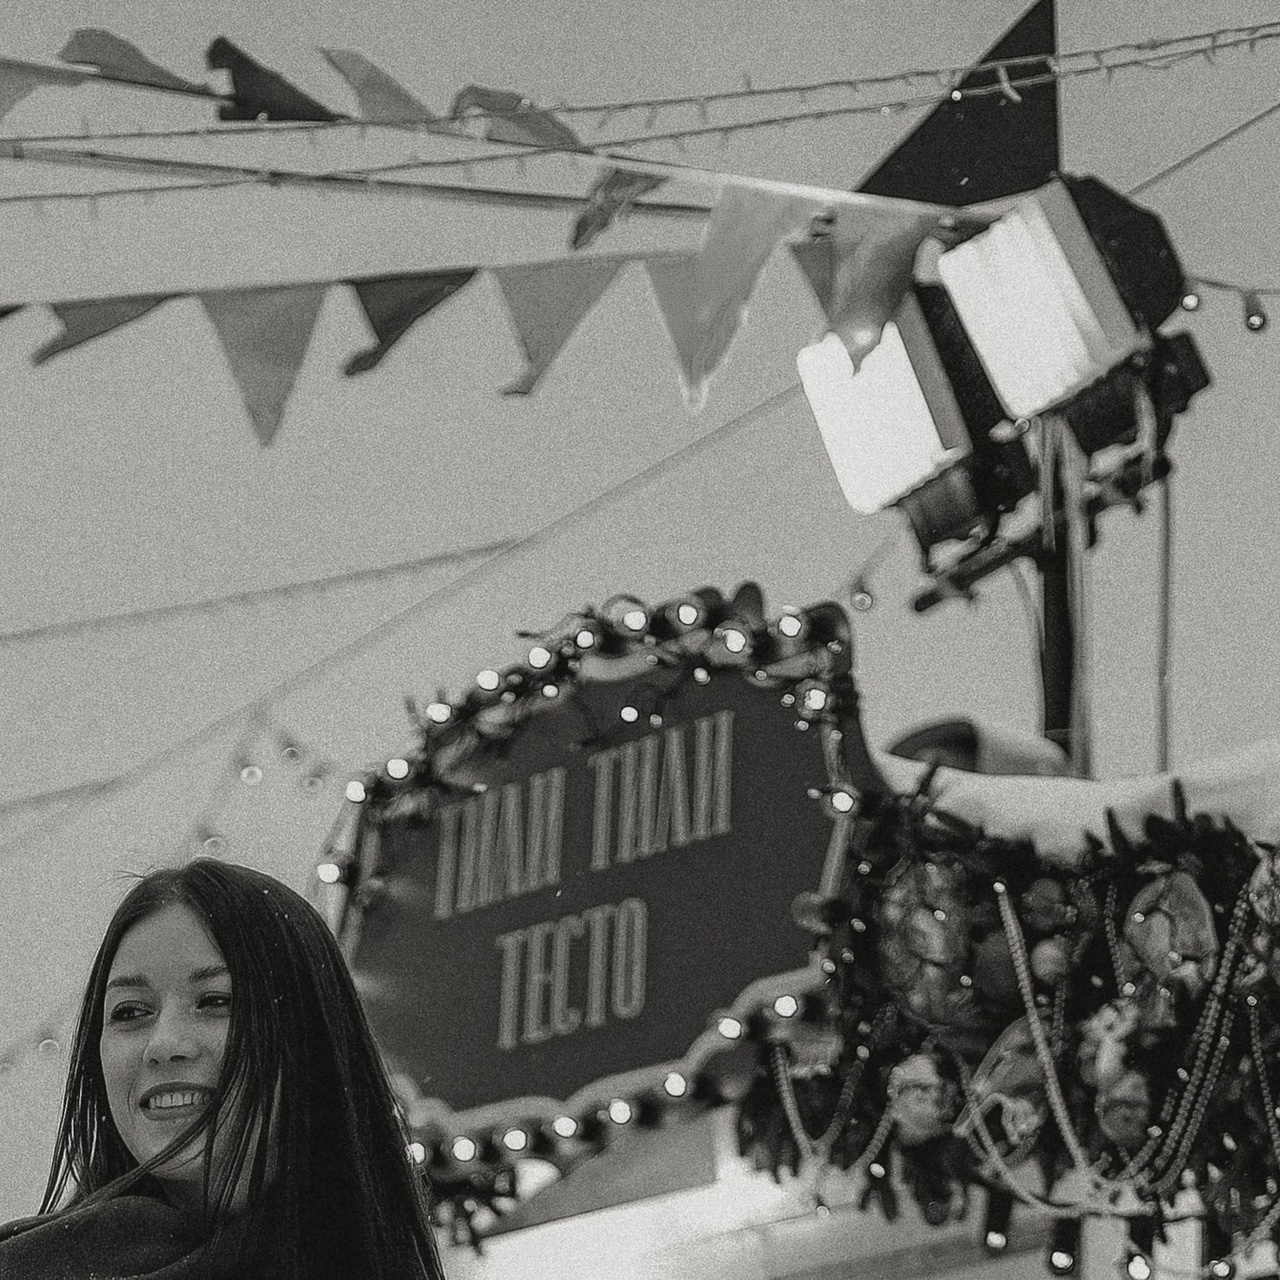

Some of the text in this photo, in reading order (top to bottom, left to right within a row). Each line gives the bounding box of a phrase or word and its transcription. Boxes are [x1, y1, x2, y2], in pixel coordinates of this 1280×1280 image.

[434, 710, 734, 920] ТИЛИ ТИЛИ
[496, 898, 647, 1050] ТЕСТО
